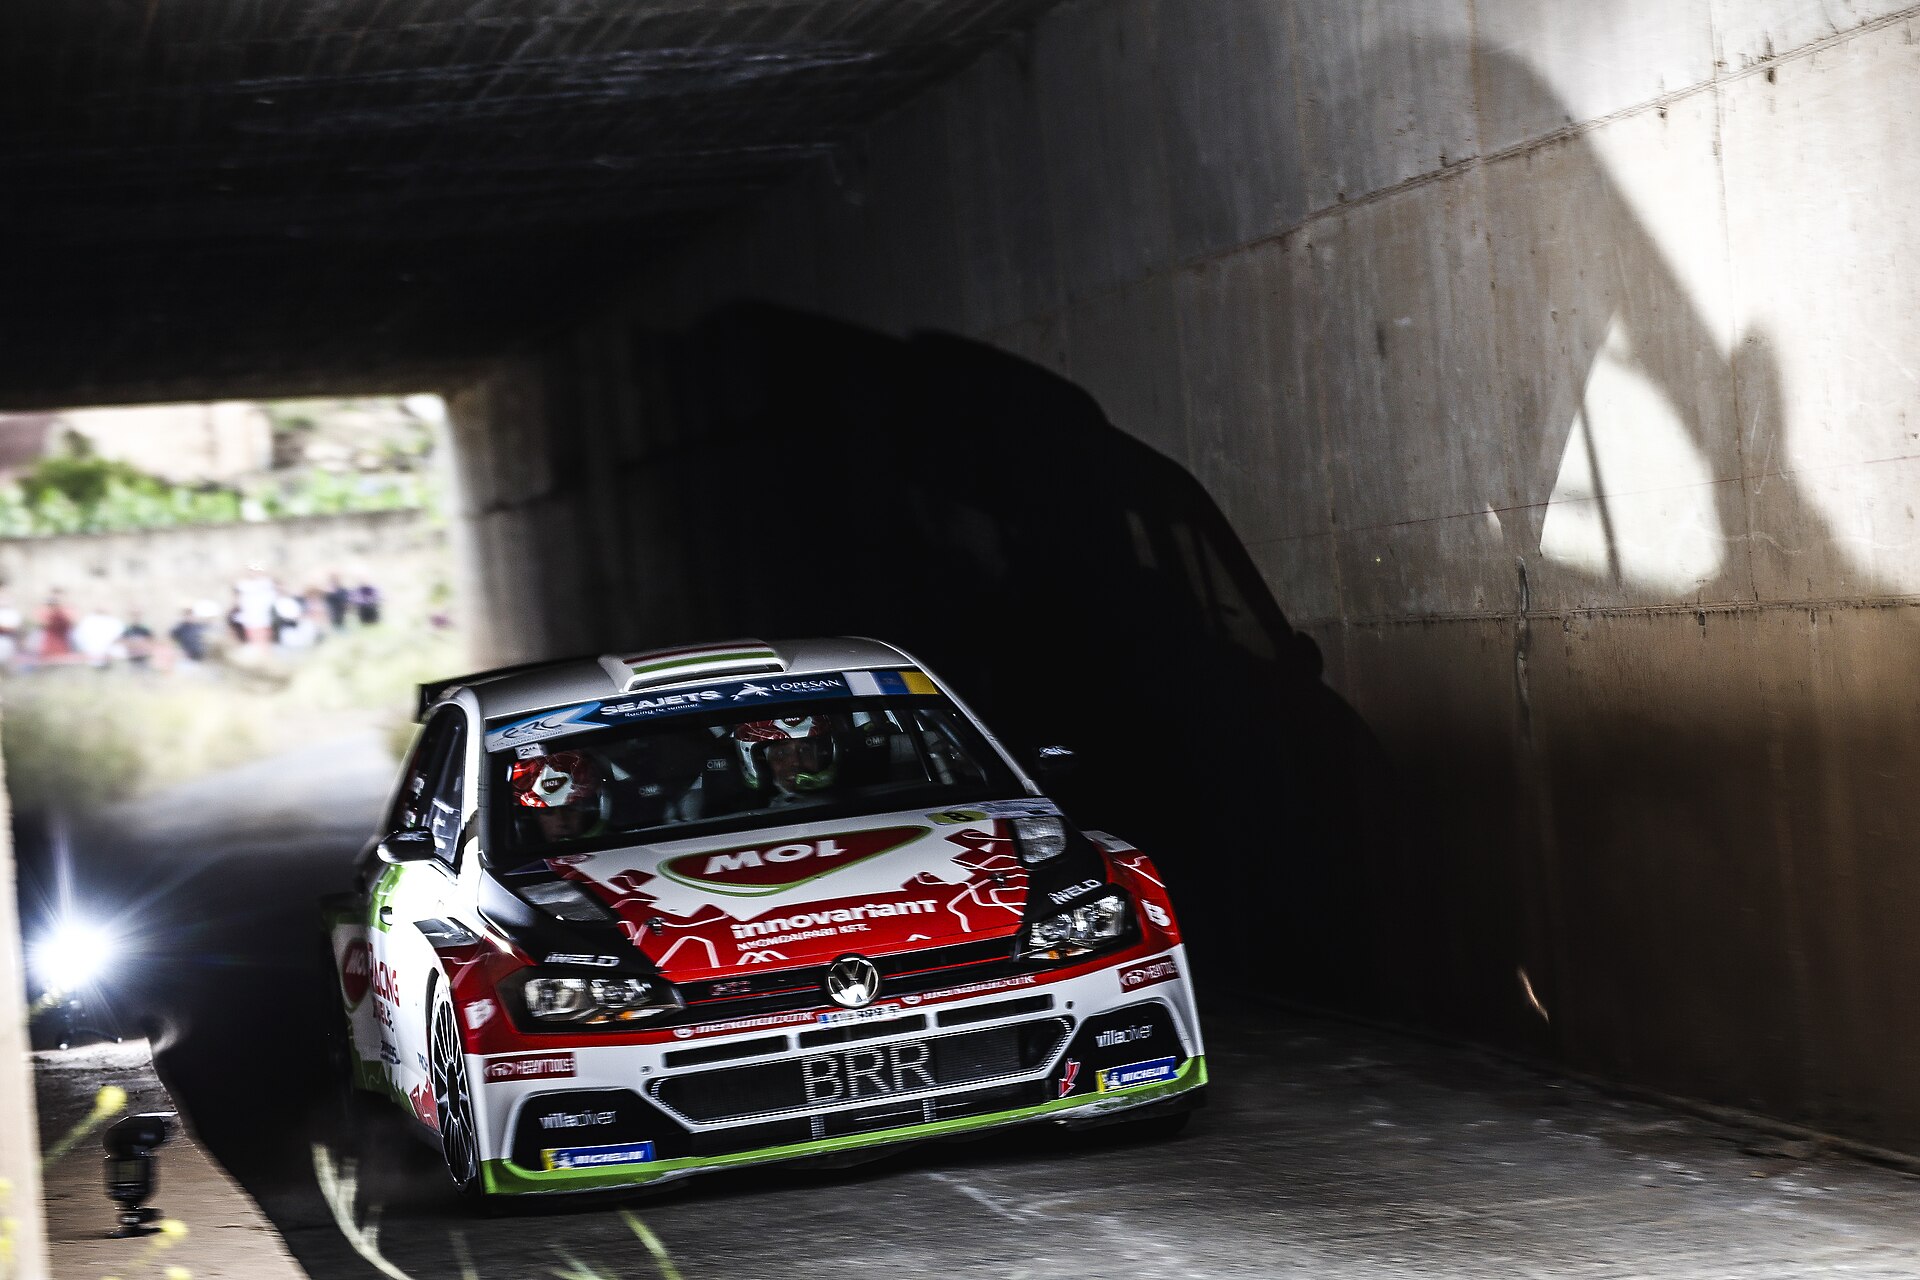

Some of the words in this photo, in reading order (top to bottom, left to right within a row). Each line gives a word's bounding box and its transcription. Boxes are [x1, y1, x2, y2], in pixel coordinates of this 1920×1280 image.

[772, 679, 841, 692] LOPESAN
[599, 690, 722, 716] SEAJETS
[703, 839, 847, 875] MOL
[800, 1040, 937, 1104] BRR
